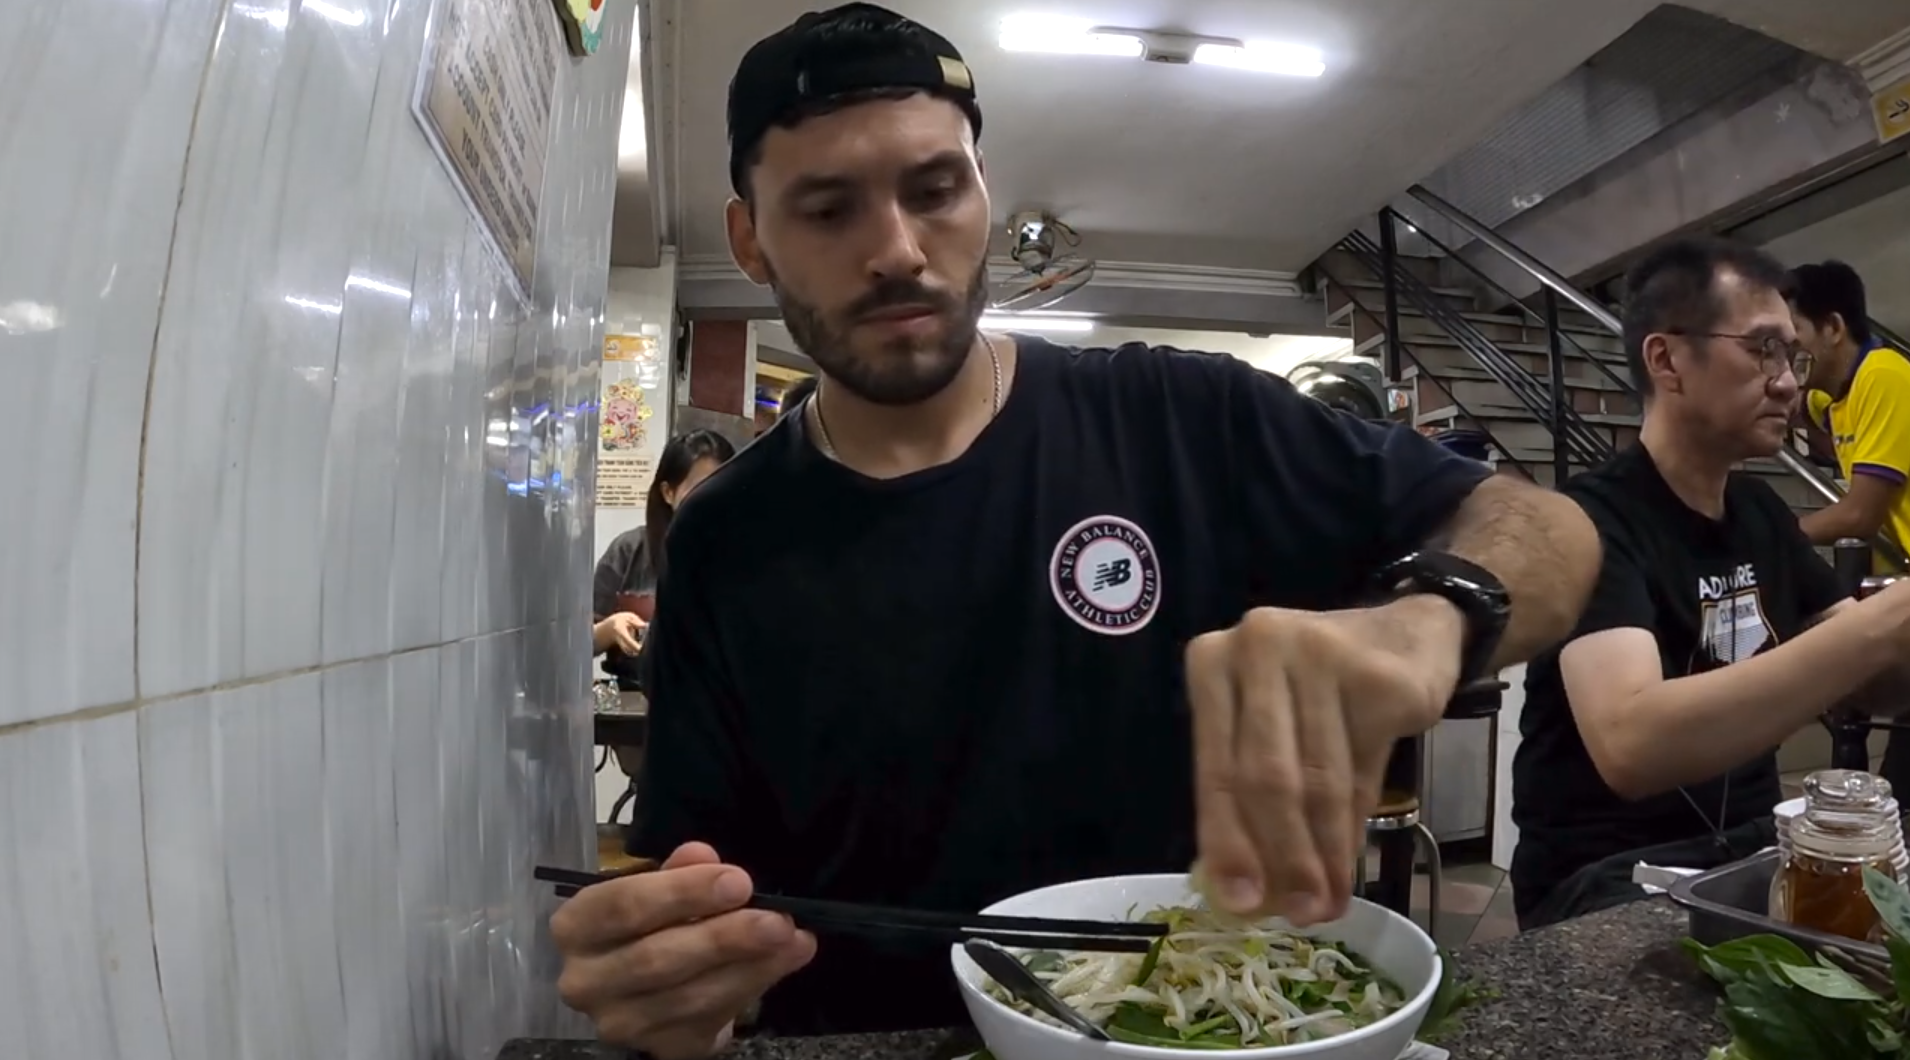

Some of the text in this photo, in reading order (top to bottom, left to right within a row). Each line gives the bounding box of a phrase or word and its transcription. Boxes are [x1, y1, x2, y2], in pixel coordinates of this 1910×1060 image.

[1061, 525, 1149, 579] NEW BALANCE
[1065, 569, 1155, 626] ATHLETIC CLUB
